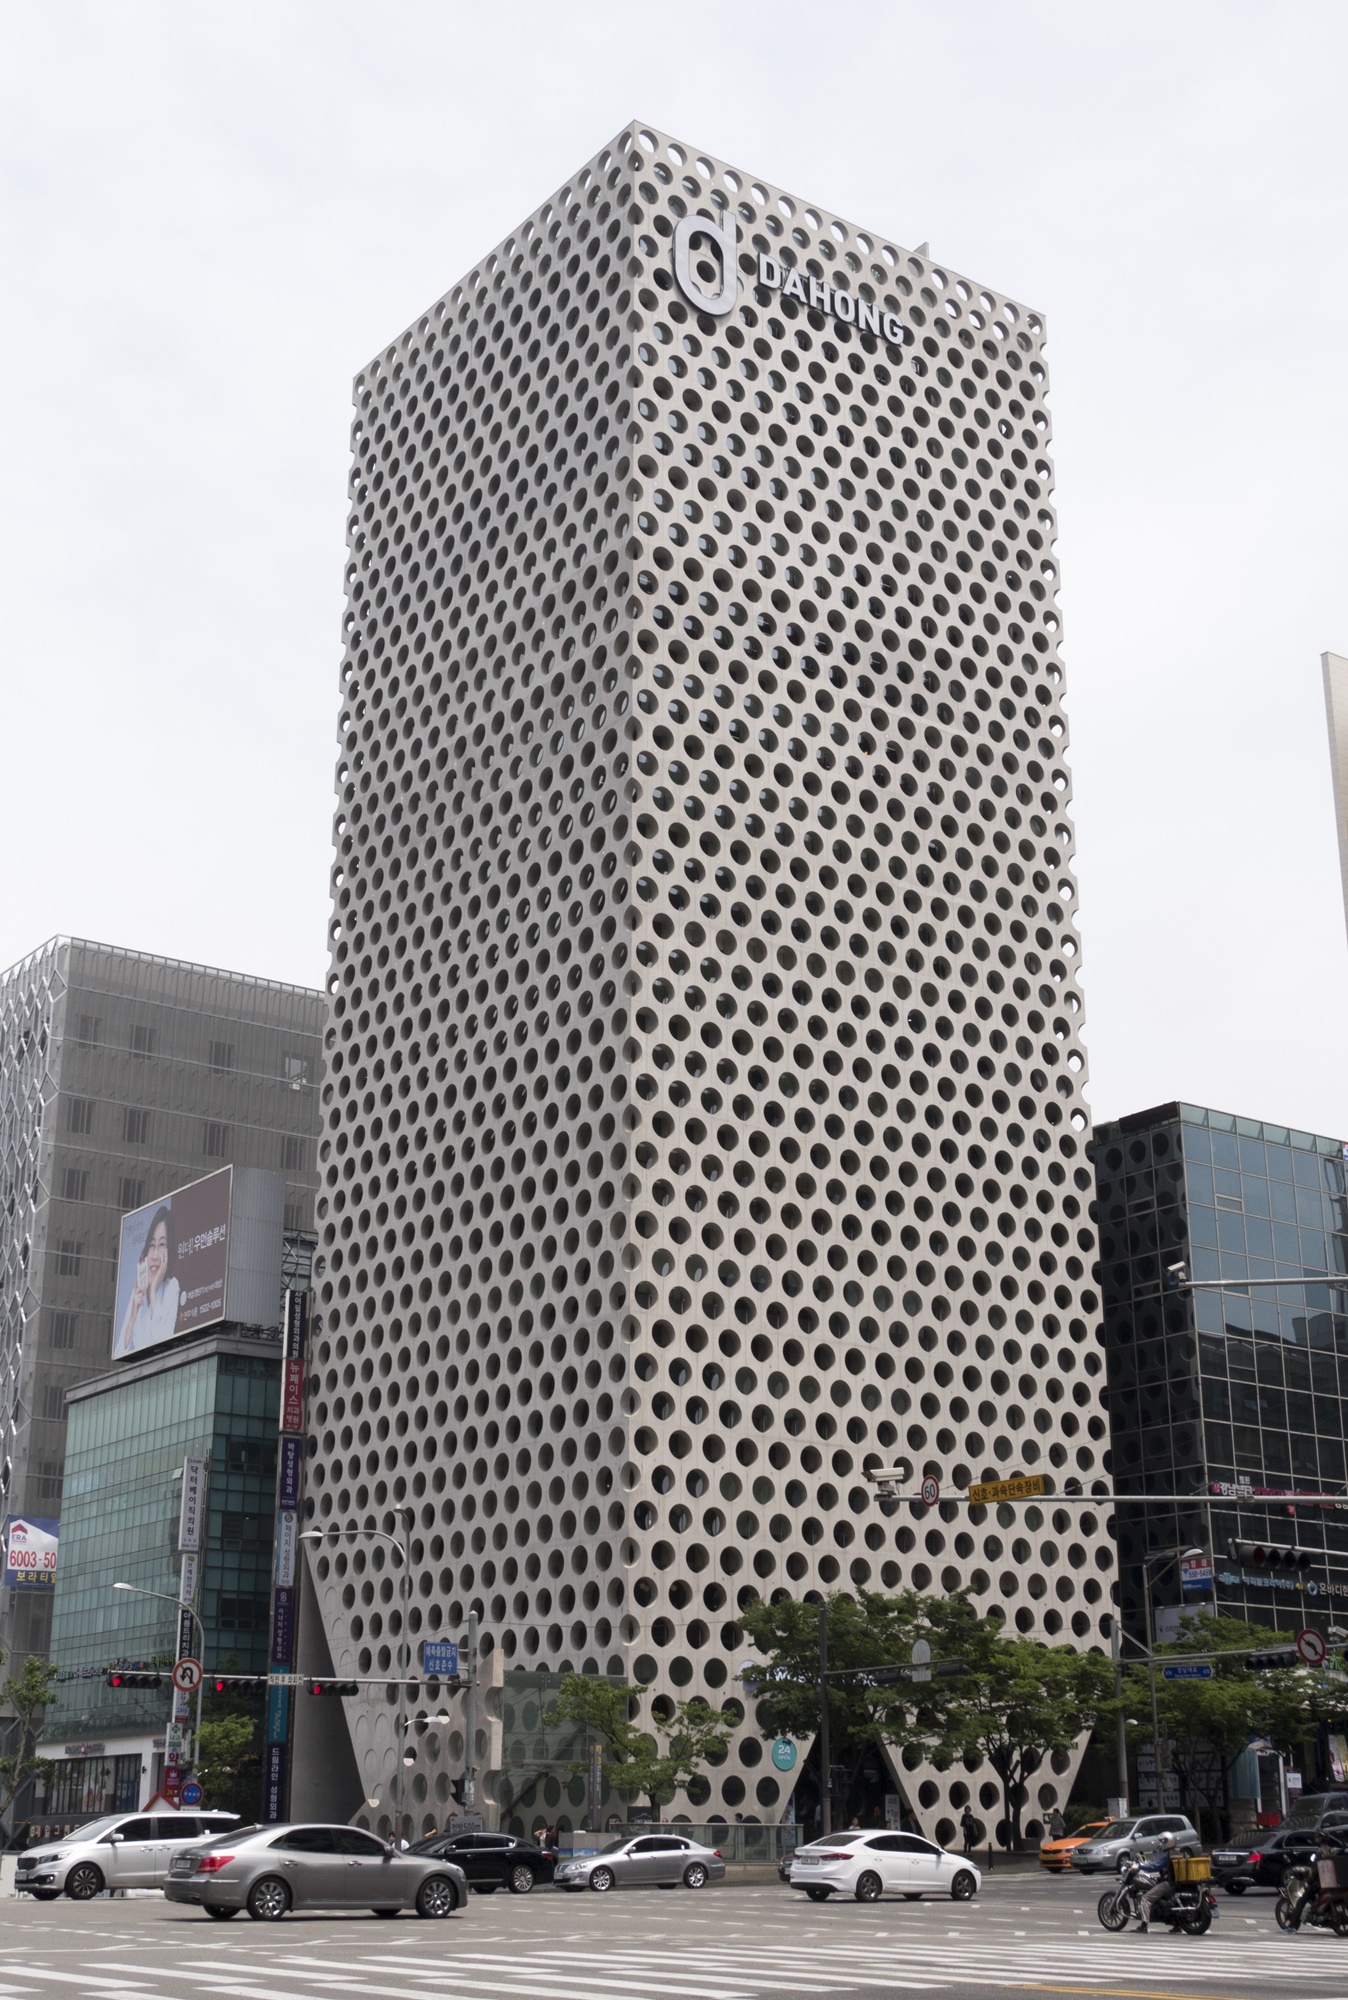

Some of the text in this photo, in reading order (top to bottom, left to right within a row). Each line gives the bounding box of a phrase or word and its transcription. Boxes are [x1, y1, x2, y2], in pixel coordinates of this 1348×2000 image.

[757, 252, 906, 345] DAHONG
[288, 1362, 300, 1405] 뉴페이스
[186, 1465, 199, 1536] 닥터베이직의원
[924, 1483, 935, 1500] 60
[972, 1478, 1040, 1502] 신호·과속단속장비
[11, 1533, 27, 1541] ERA
[428, 1659, 453, 1671] 신호준수
[778, 1745, 791, 1754] 24
[269, 1785, 278, 1819] 성형외과
